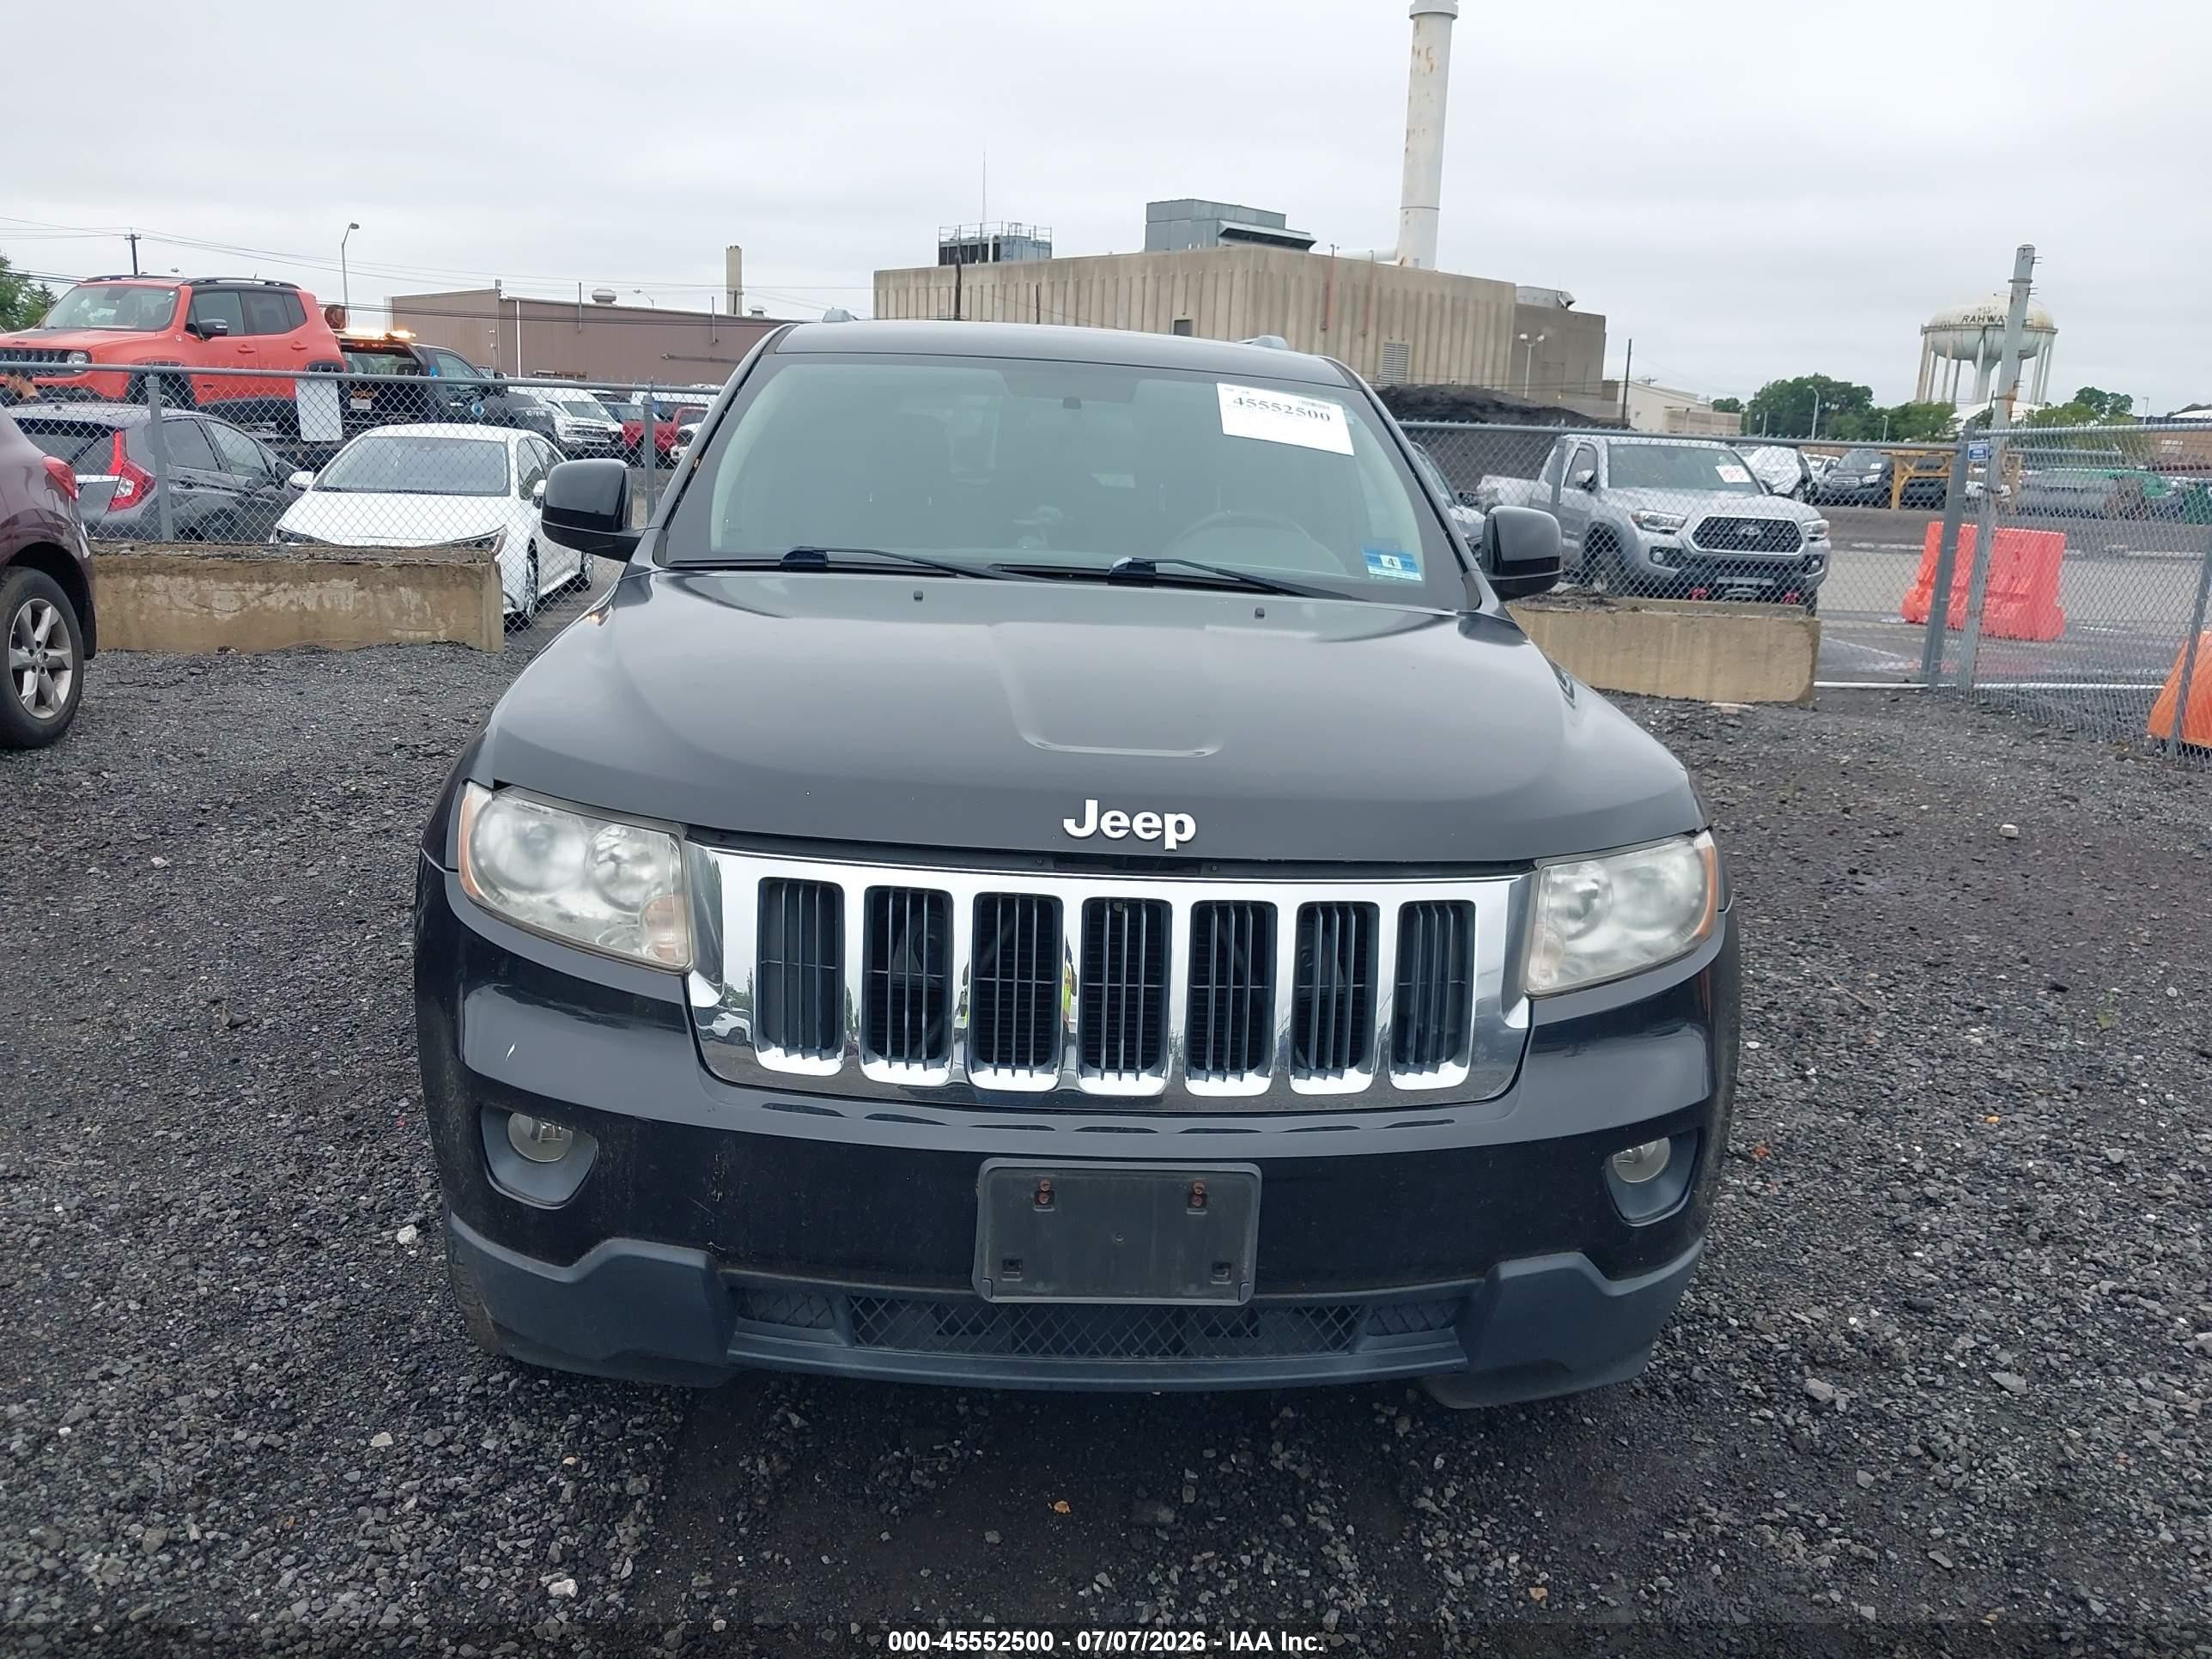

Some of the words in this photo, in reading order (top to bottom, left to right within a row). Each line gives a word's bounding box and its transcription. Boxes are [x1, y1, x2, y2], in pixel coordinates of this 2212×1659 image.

[1233, 396, 1331, 422] 45552500
[1388, 557, 1395, 567] 4
[1063, 799, 1196, 851] Jeep
